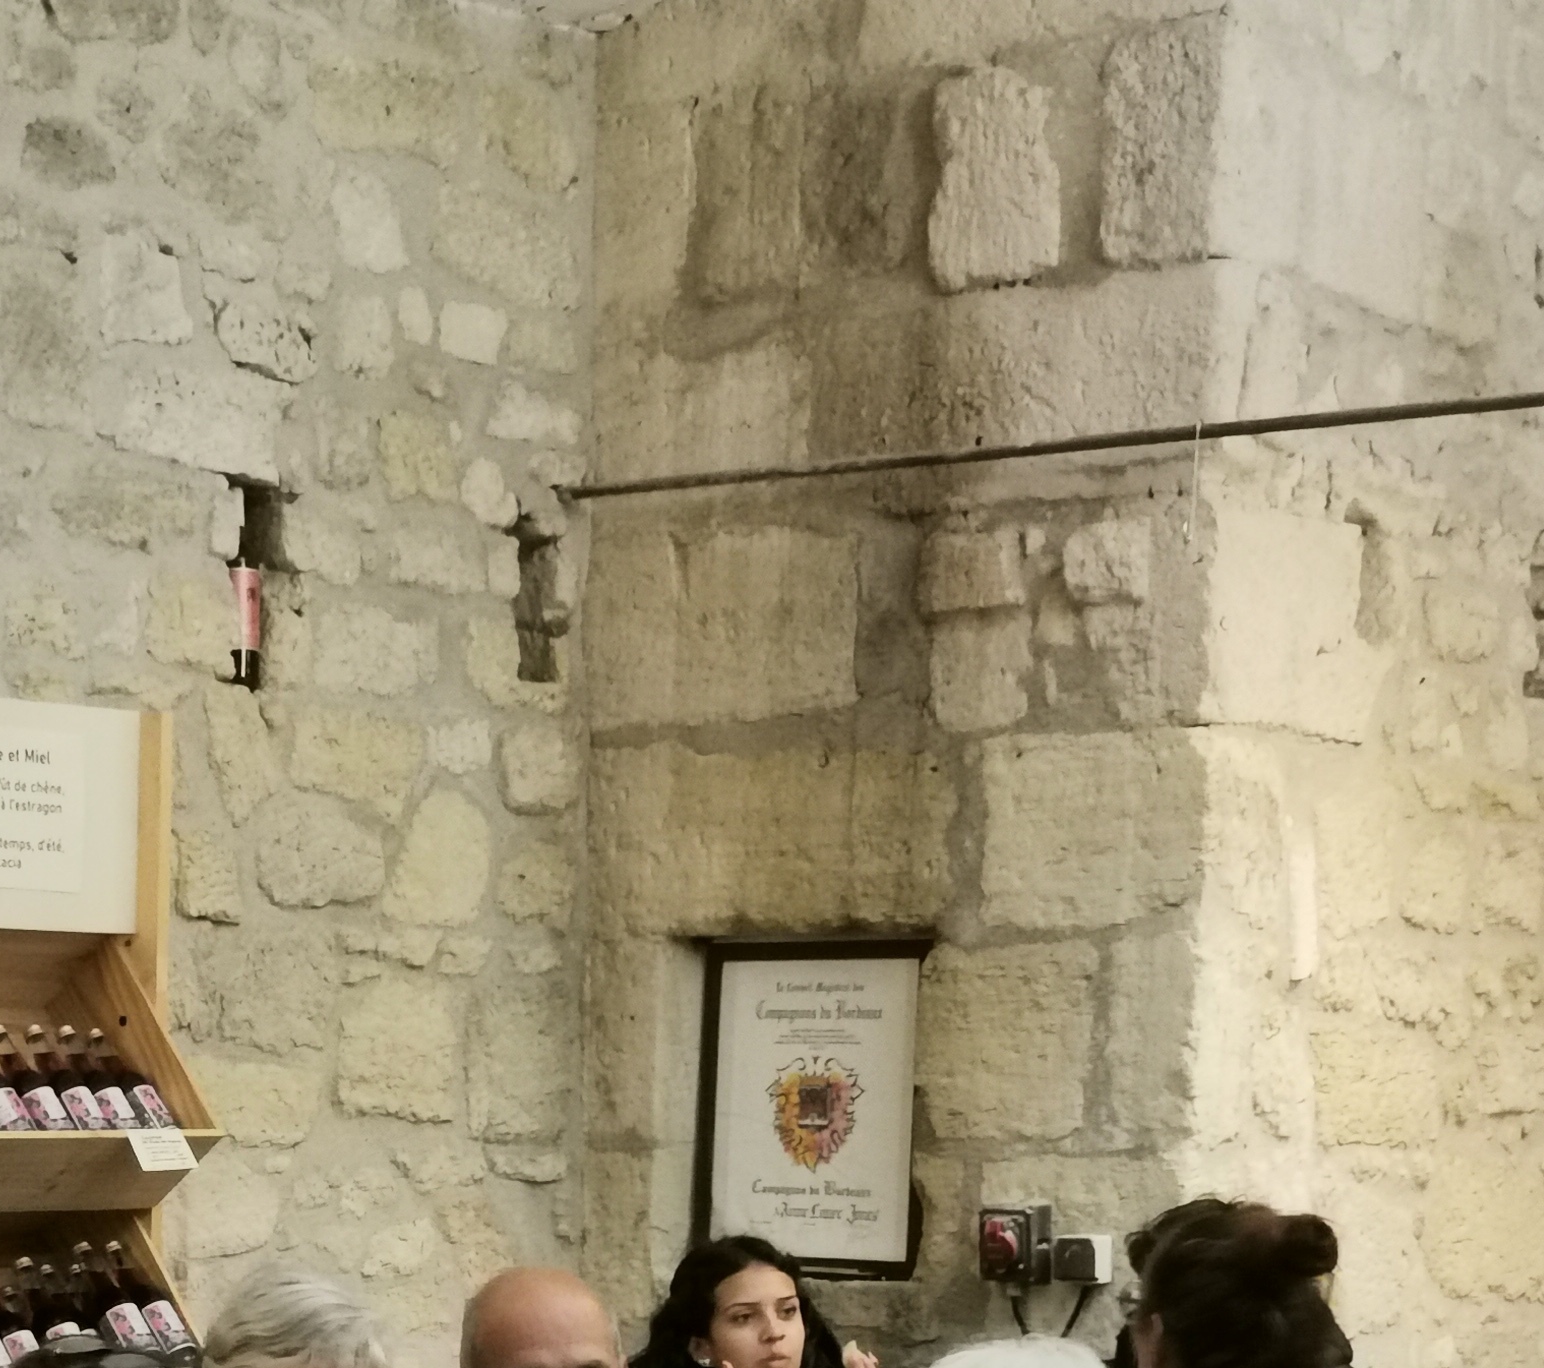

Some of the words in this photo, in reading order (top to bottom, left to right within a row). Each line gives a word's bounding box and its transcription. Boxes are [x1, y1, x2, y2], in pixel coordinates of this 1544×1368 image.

[8, 749, 19, 762] et
[24, 748, 50, 765] Miel
[14, 780, 27, 792] de
